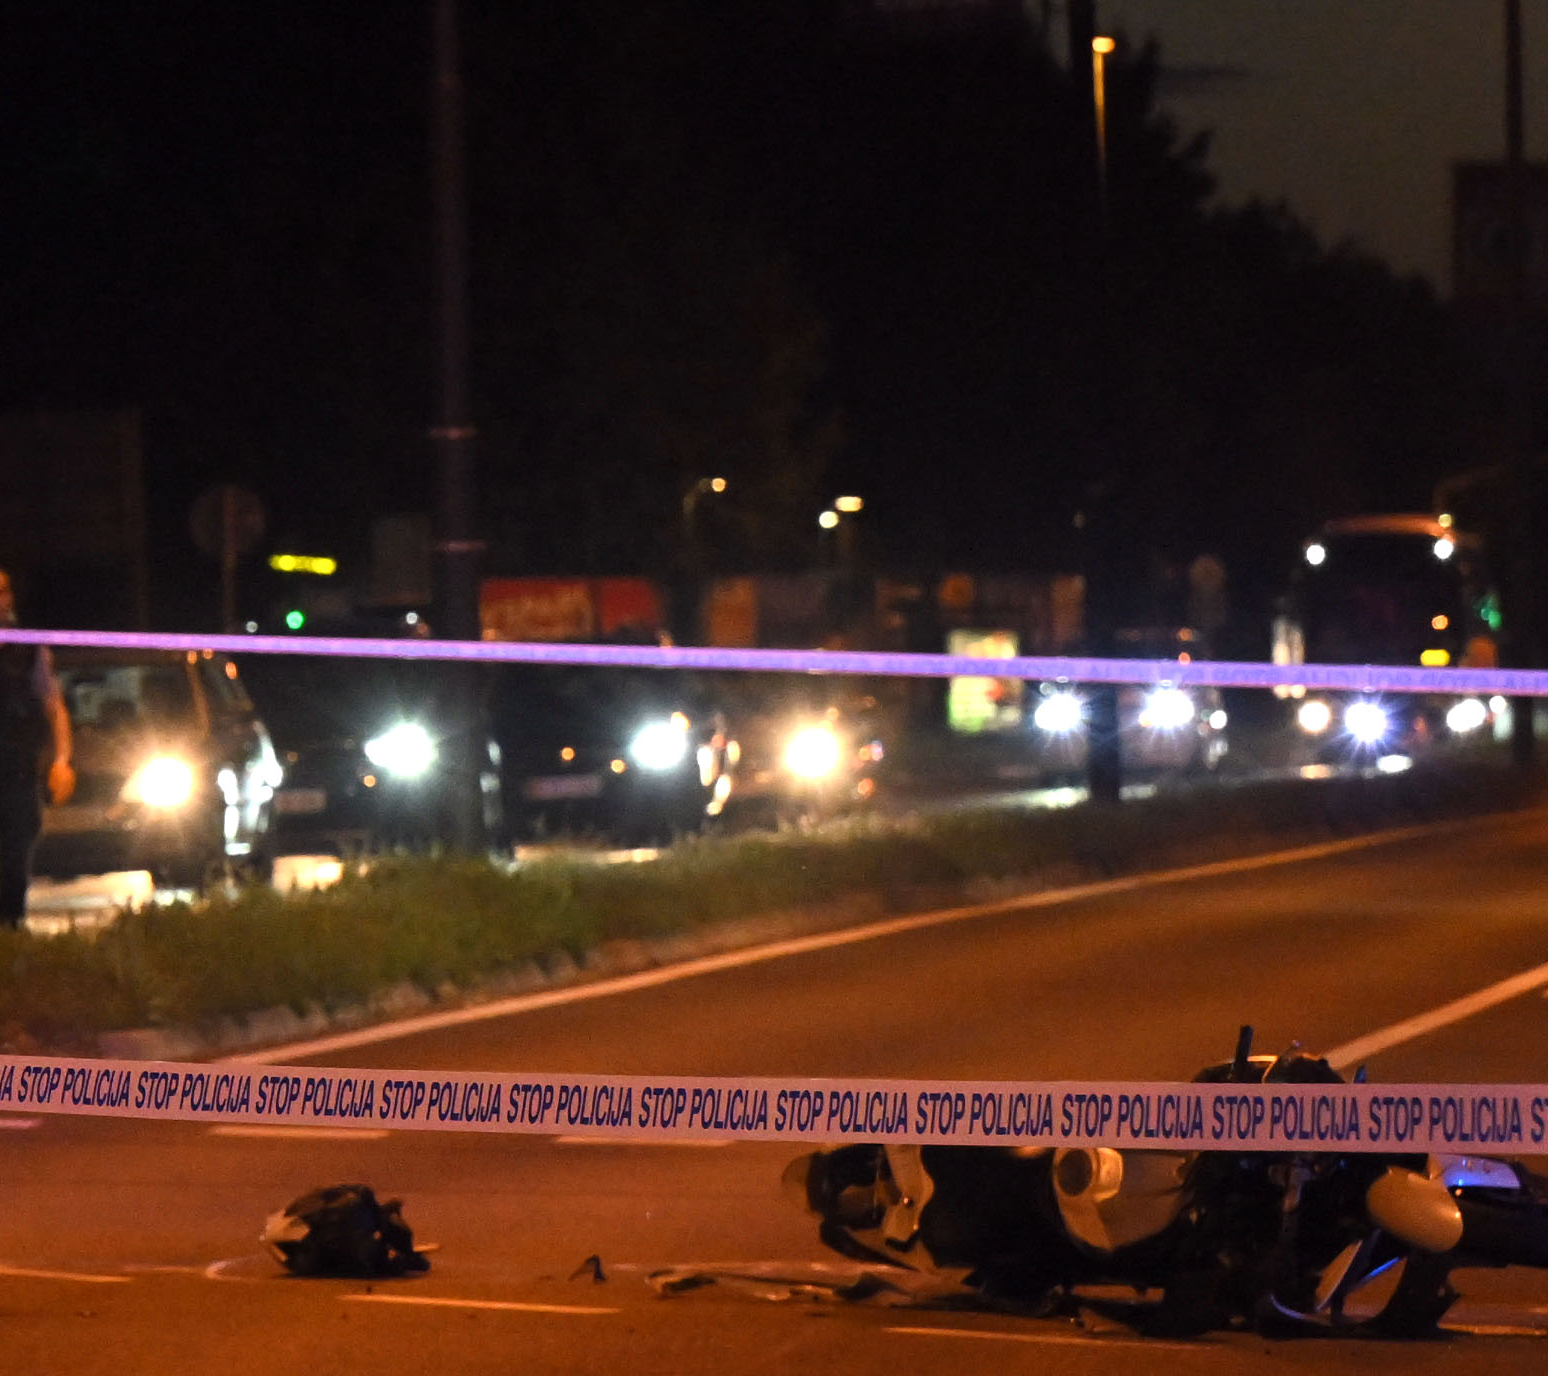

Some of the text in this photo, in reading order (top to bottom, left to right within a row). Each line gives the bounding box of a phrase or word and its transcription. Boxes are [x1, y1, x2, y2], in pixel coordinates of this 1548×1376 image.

[17, 1065, 61, 1104] STOP
[60, 1067, 132, 1107] POLICIJA
[135, 1071, 180, 1110] STOP
[179, 1073, 252, 1113] POLICIJA
[255, 1076, 301, 1115] STOP
[301, 1078, 375, 1119] POLICIJA
[379, 1079, 426, 1121] STOP
[426, 1081, 502, 1122] POLICIJA
[507, 1083, 555, 1124] STOP
[555, 1085, 633, 1126] POLICIJA
[638, 1086, 687, 1128] STOP
[688, 1088, 768, 1130] POLICIJA
[774, 1089, 824, 1132] STOP
[827, 1090, 908, 1134] POLICIJA
[915, 1091, 966, 1135] STOP
[968, 1092, 1053, 1136] POLICIJA
[1060, 1093, 1113, 1137] STOP
[1116, 1094, 1204, 1139] POLICIJA
[1212, 1095, 1266, 1139] STOP
[1269, 1095, 1361, 1141] POLICIJA
[1369, 1096, 1424, 1142] STOP
[1429, 1096, 1522, 1143] POLICIJA
